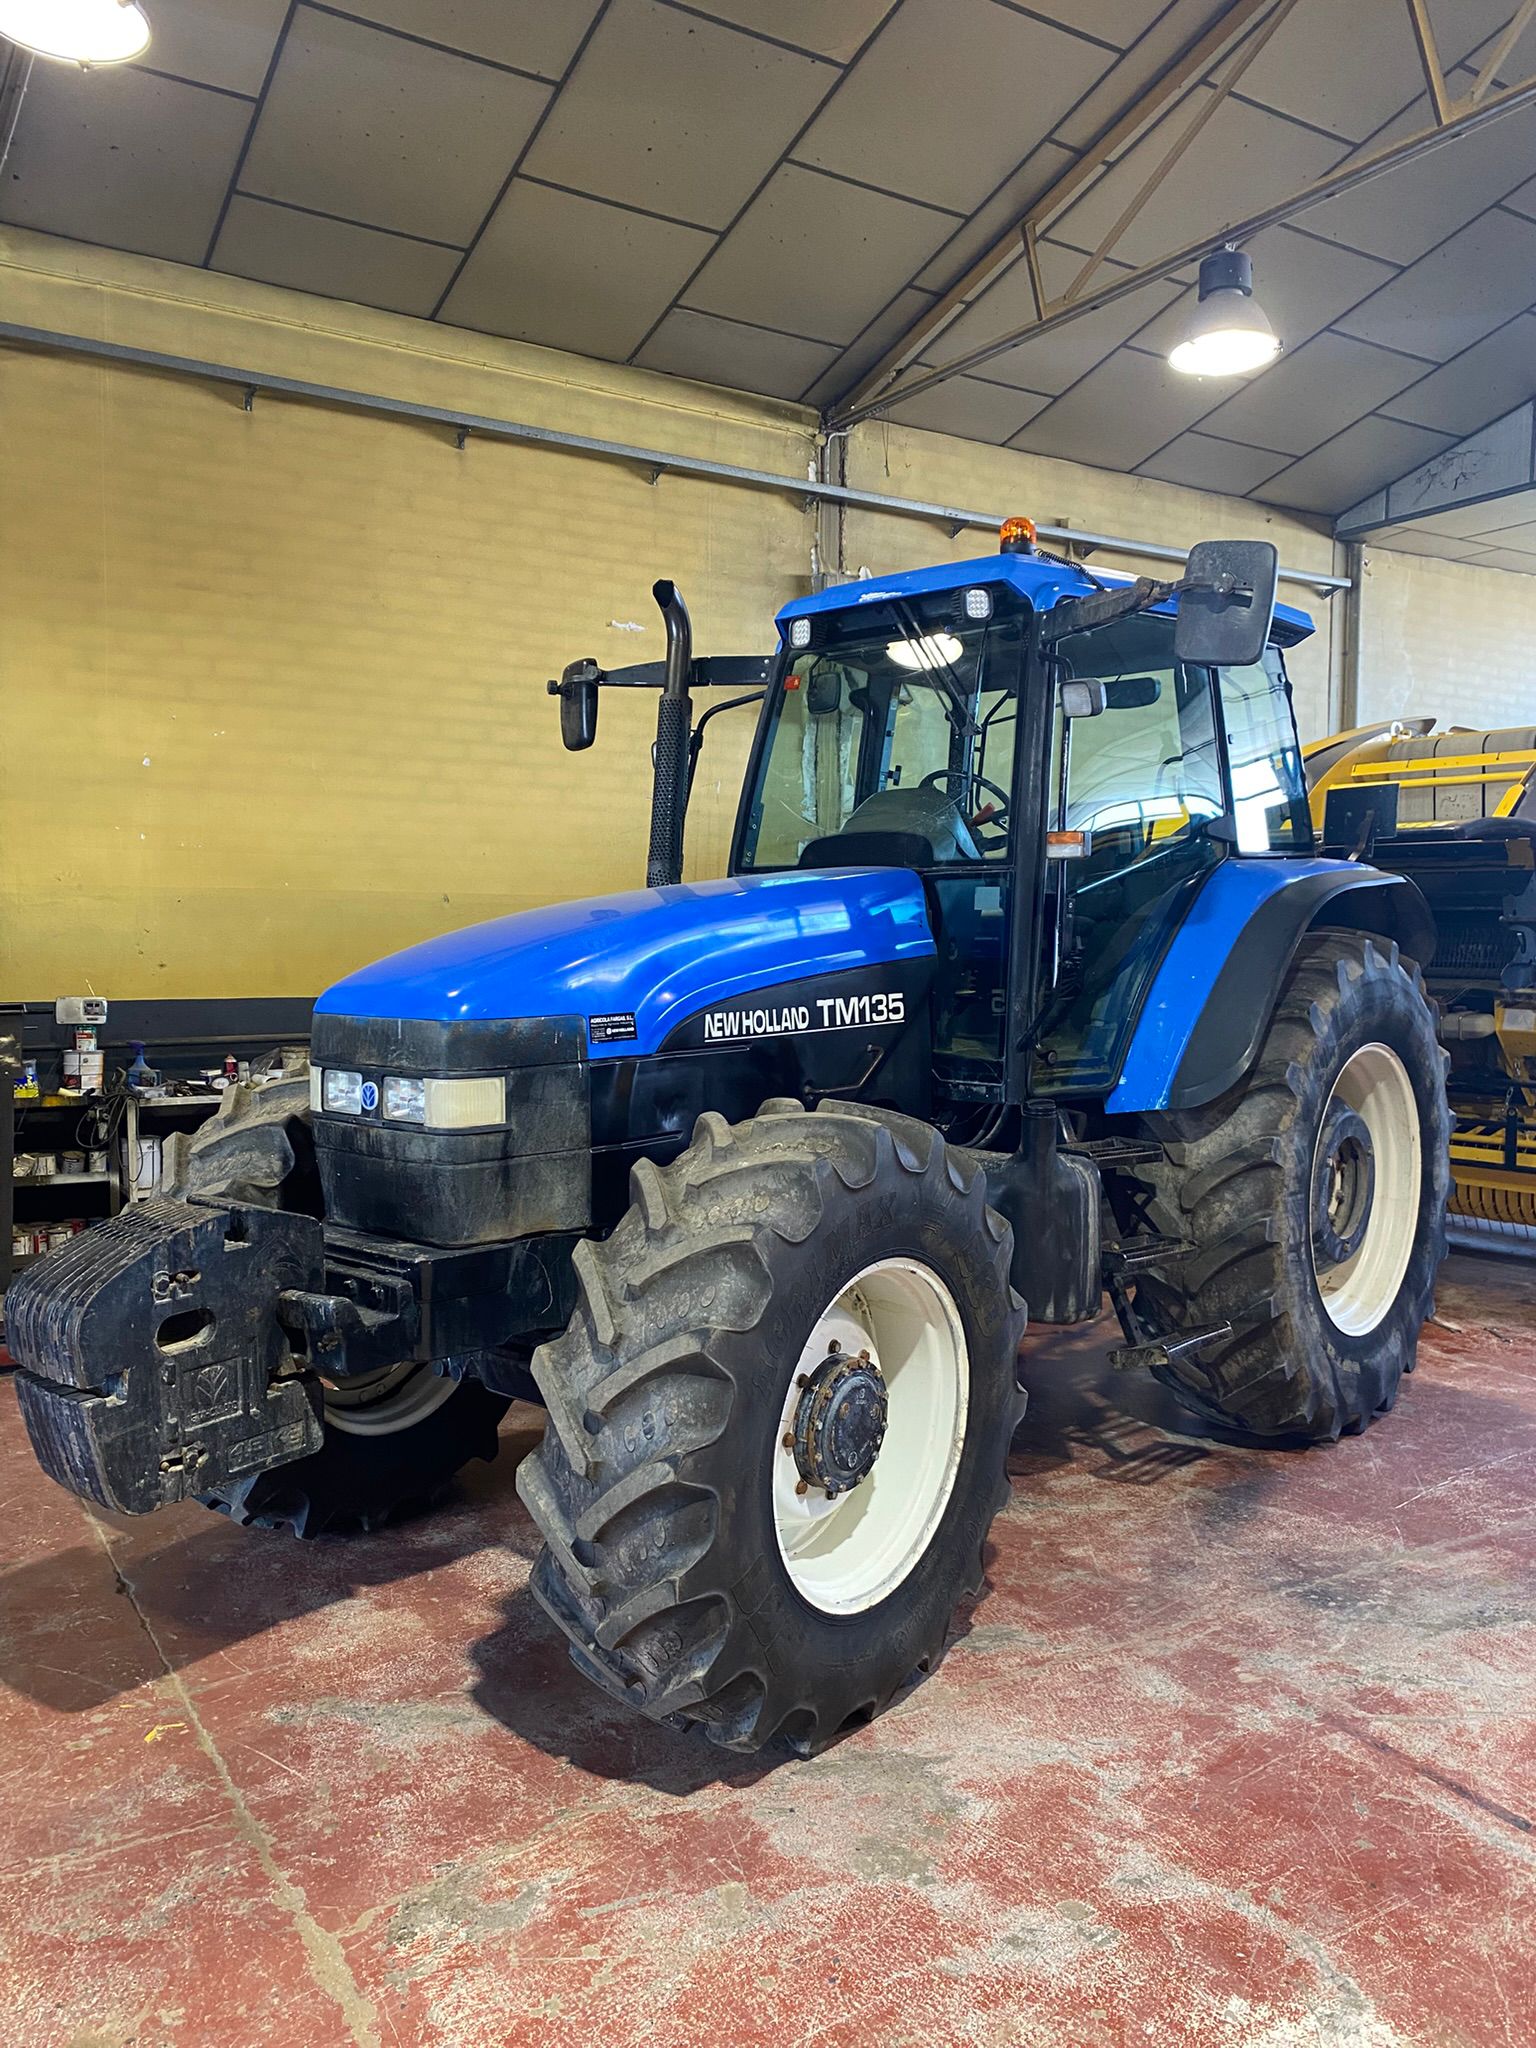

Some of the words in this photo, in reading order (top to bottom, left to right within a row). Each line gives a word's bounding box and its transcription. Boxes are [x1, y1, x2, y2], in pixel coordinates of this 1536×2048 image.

[704, 1012, 740, 1039] NEW
[741, 1006, 810, 1034] HOLLAND
[816, 993, 905, 1027] TM135
